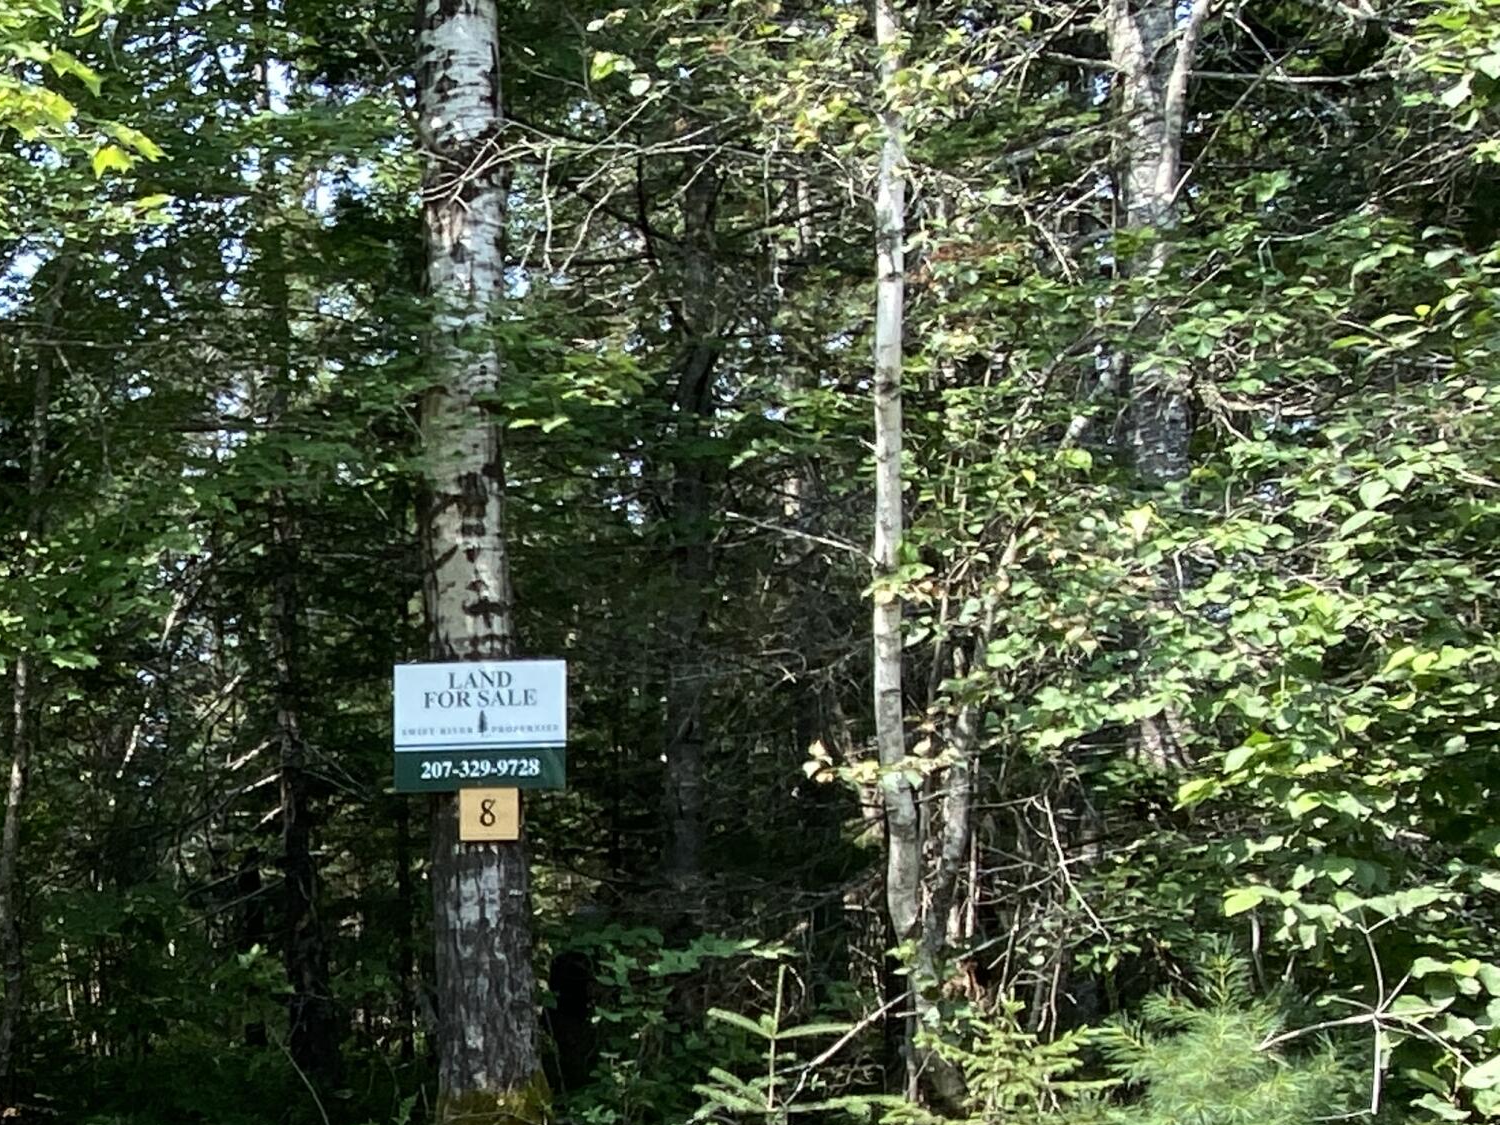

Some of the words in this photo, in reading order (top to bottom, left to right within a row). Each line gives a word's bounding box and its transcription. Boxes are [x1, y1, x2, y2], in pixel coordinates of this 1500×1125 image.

[448, 670, 512, 689] LAND
[424, 691, 471, 708] FOR
[477, 689, 537, 707] SALE
[421, 759, 540, 779] 207-329-9728
[479, 798, 496, 827] 8
